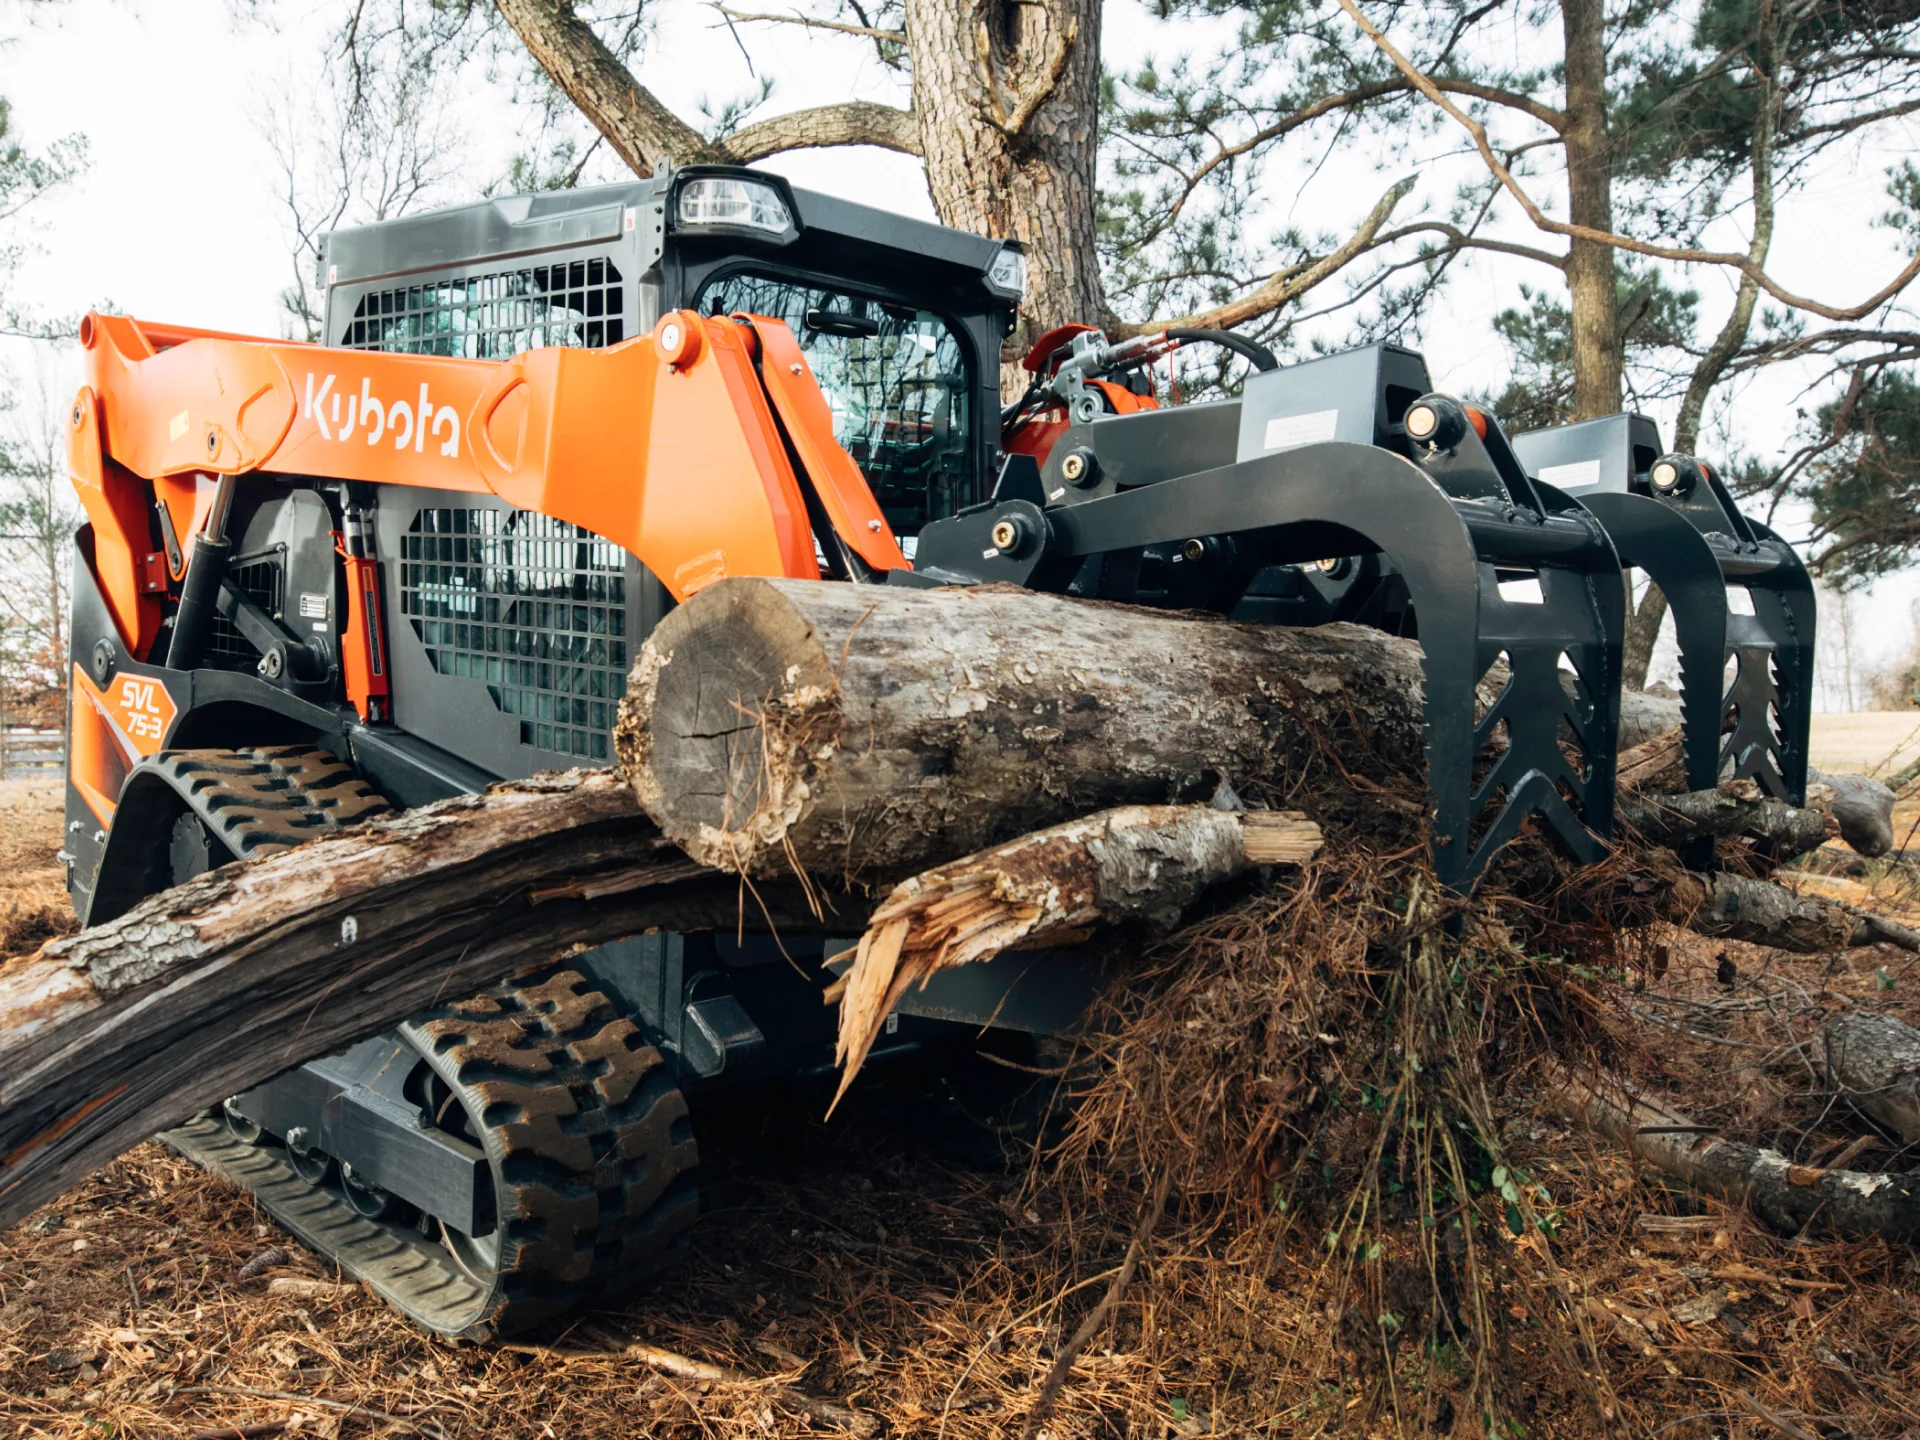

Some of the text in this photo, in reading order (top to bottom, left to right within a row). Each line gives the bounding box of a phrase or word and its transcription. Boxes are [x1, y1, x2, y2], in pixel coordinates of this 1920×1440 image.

[304, 372, 460, 458] Kubota
[120, 680, 160, 714] SVL
[127, 711, 163, 739] 75-3
